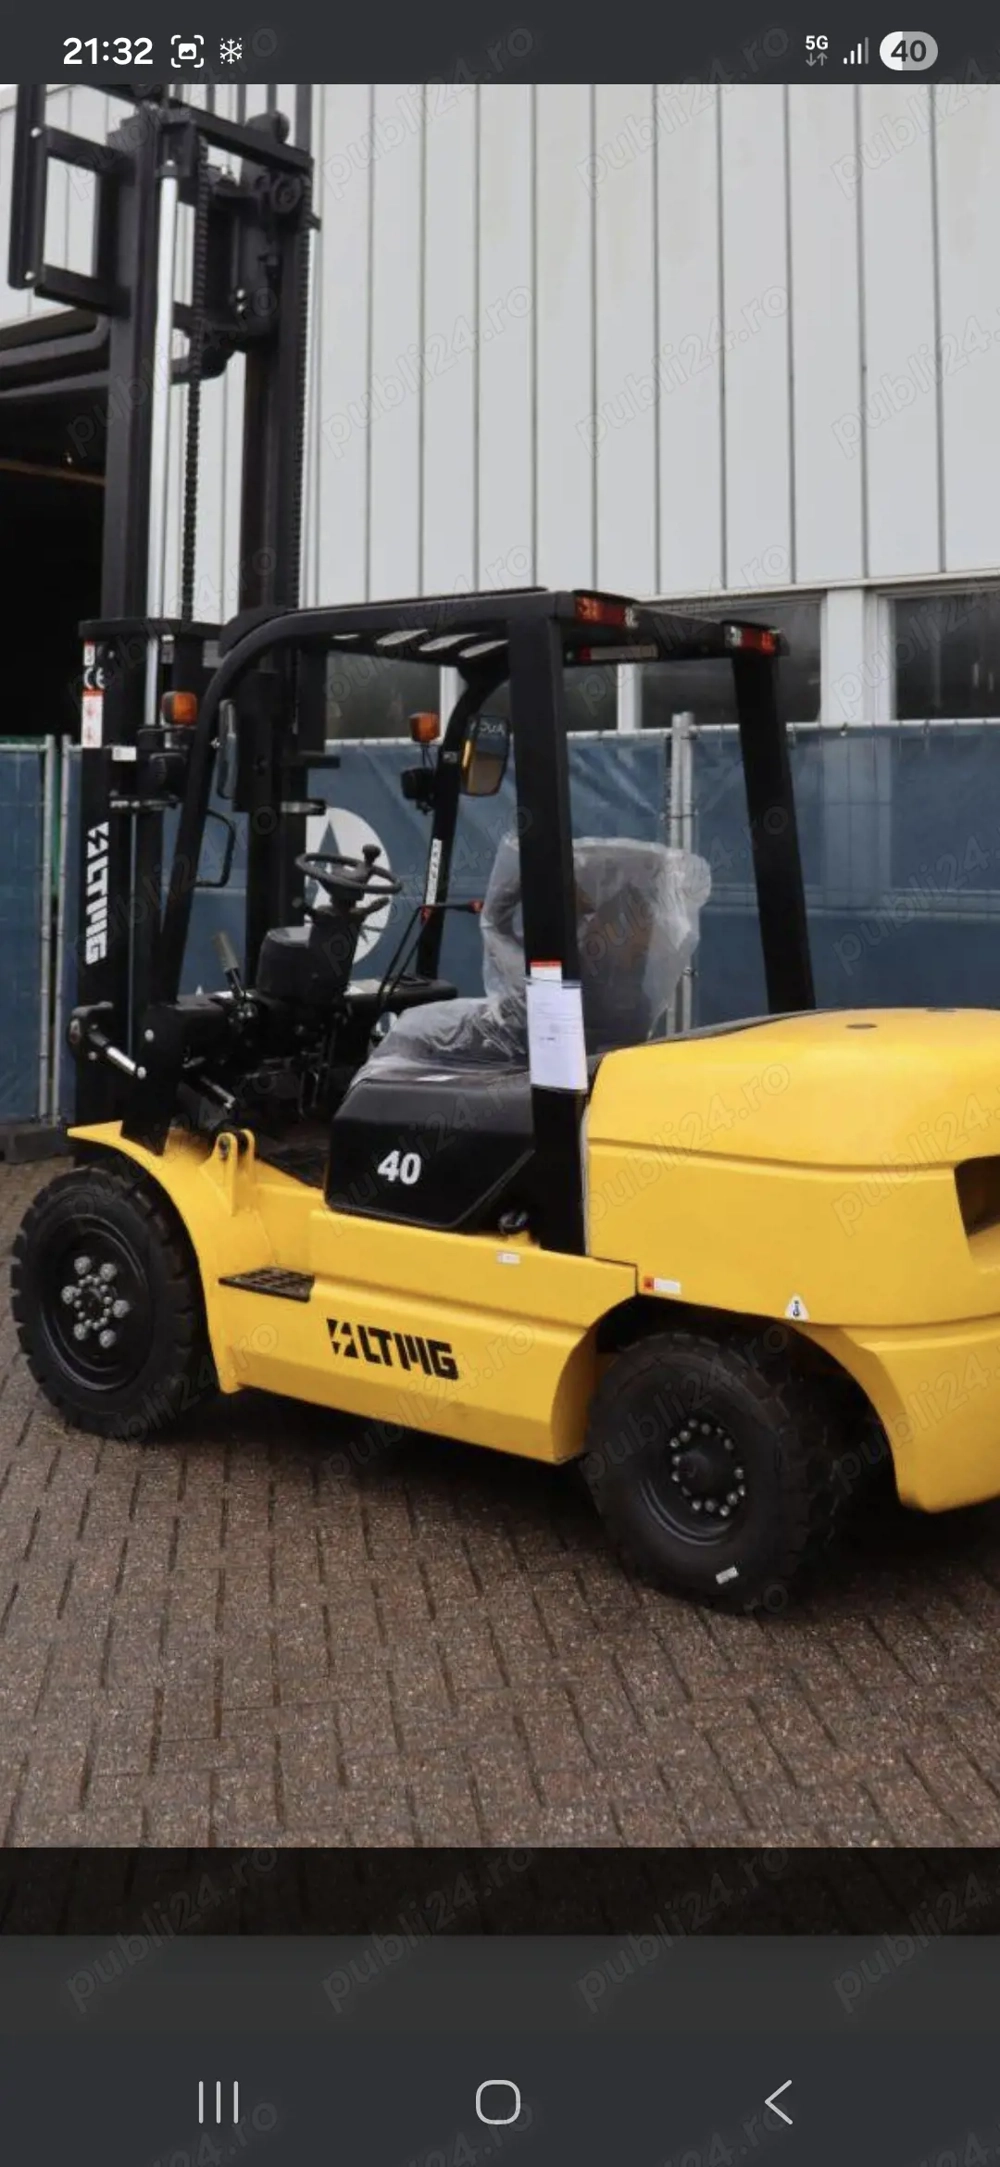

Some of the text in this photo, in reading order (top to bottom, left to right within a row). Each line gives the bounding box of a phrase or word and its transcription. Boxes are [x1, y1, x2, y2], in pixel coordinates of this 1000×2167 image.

[63, 37, 153, 65] 21:32
[805, 35, 829, 50] 5G
[890, 39, 927, 62] 40
[84, 667, 104, 689] CE
[86, 855, 109, 965] LTMG
[377, 1150, 421, 1185] 40
[357, 1324, 459, 1381] LTMG
